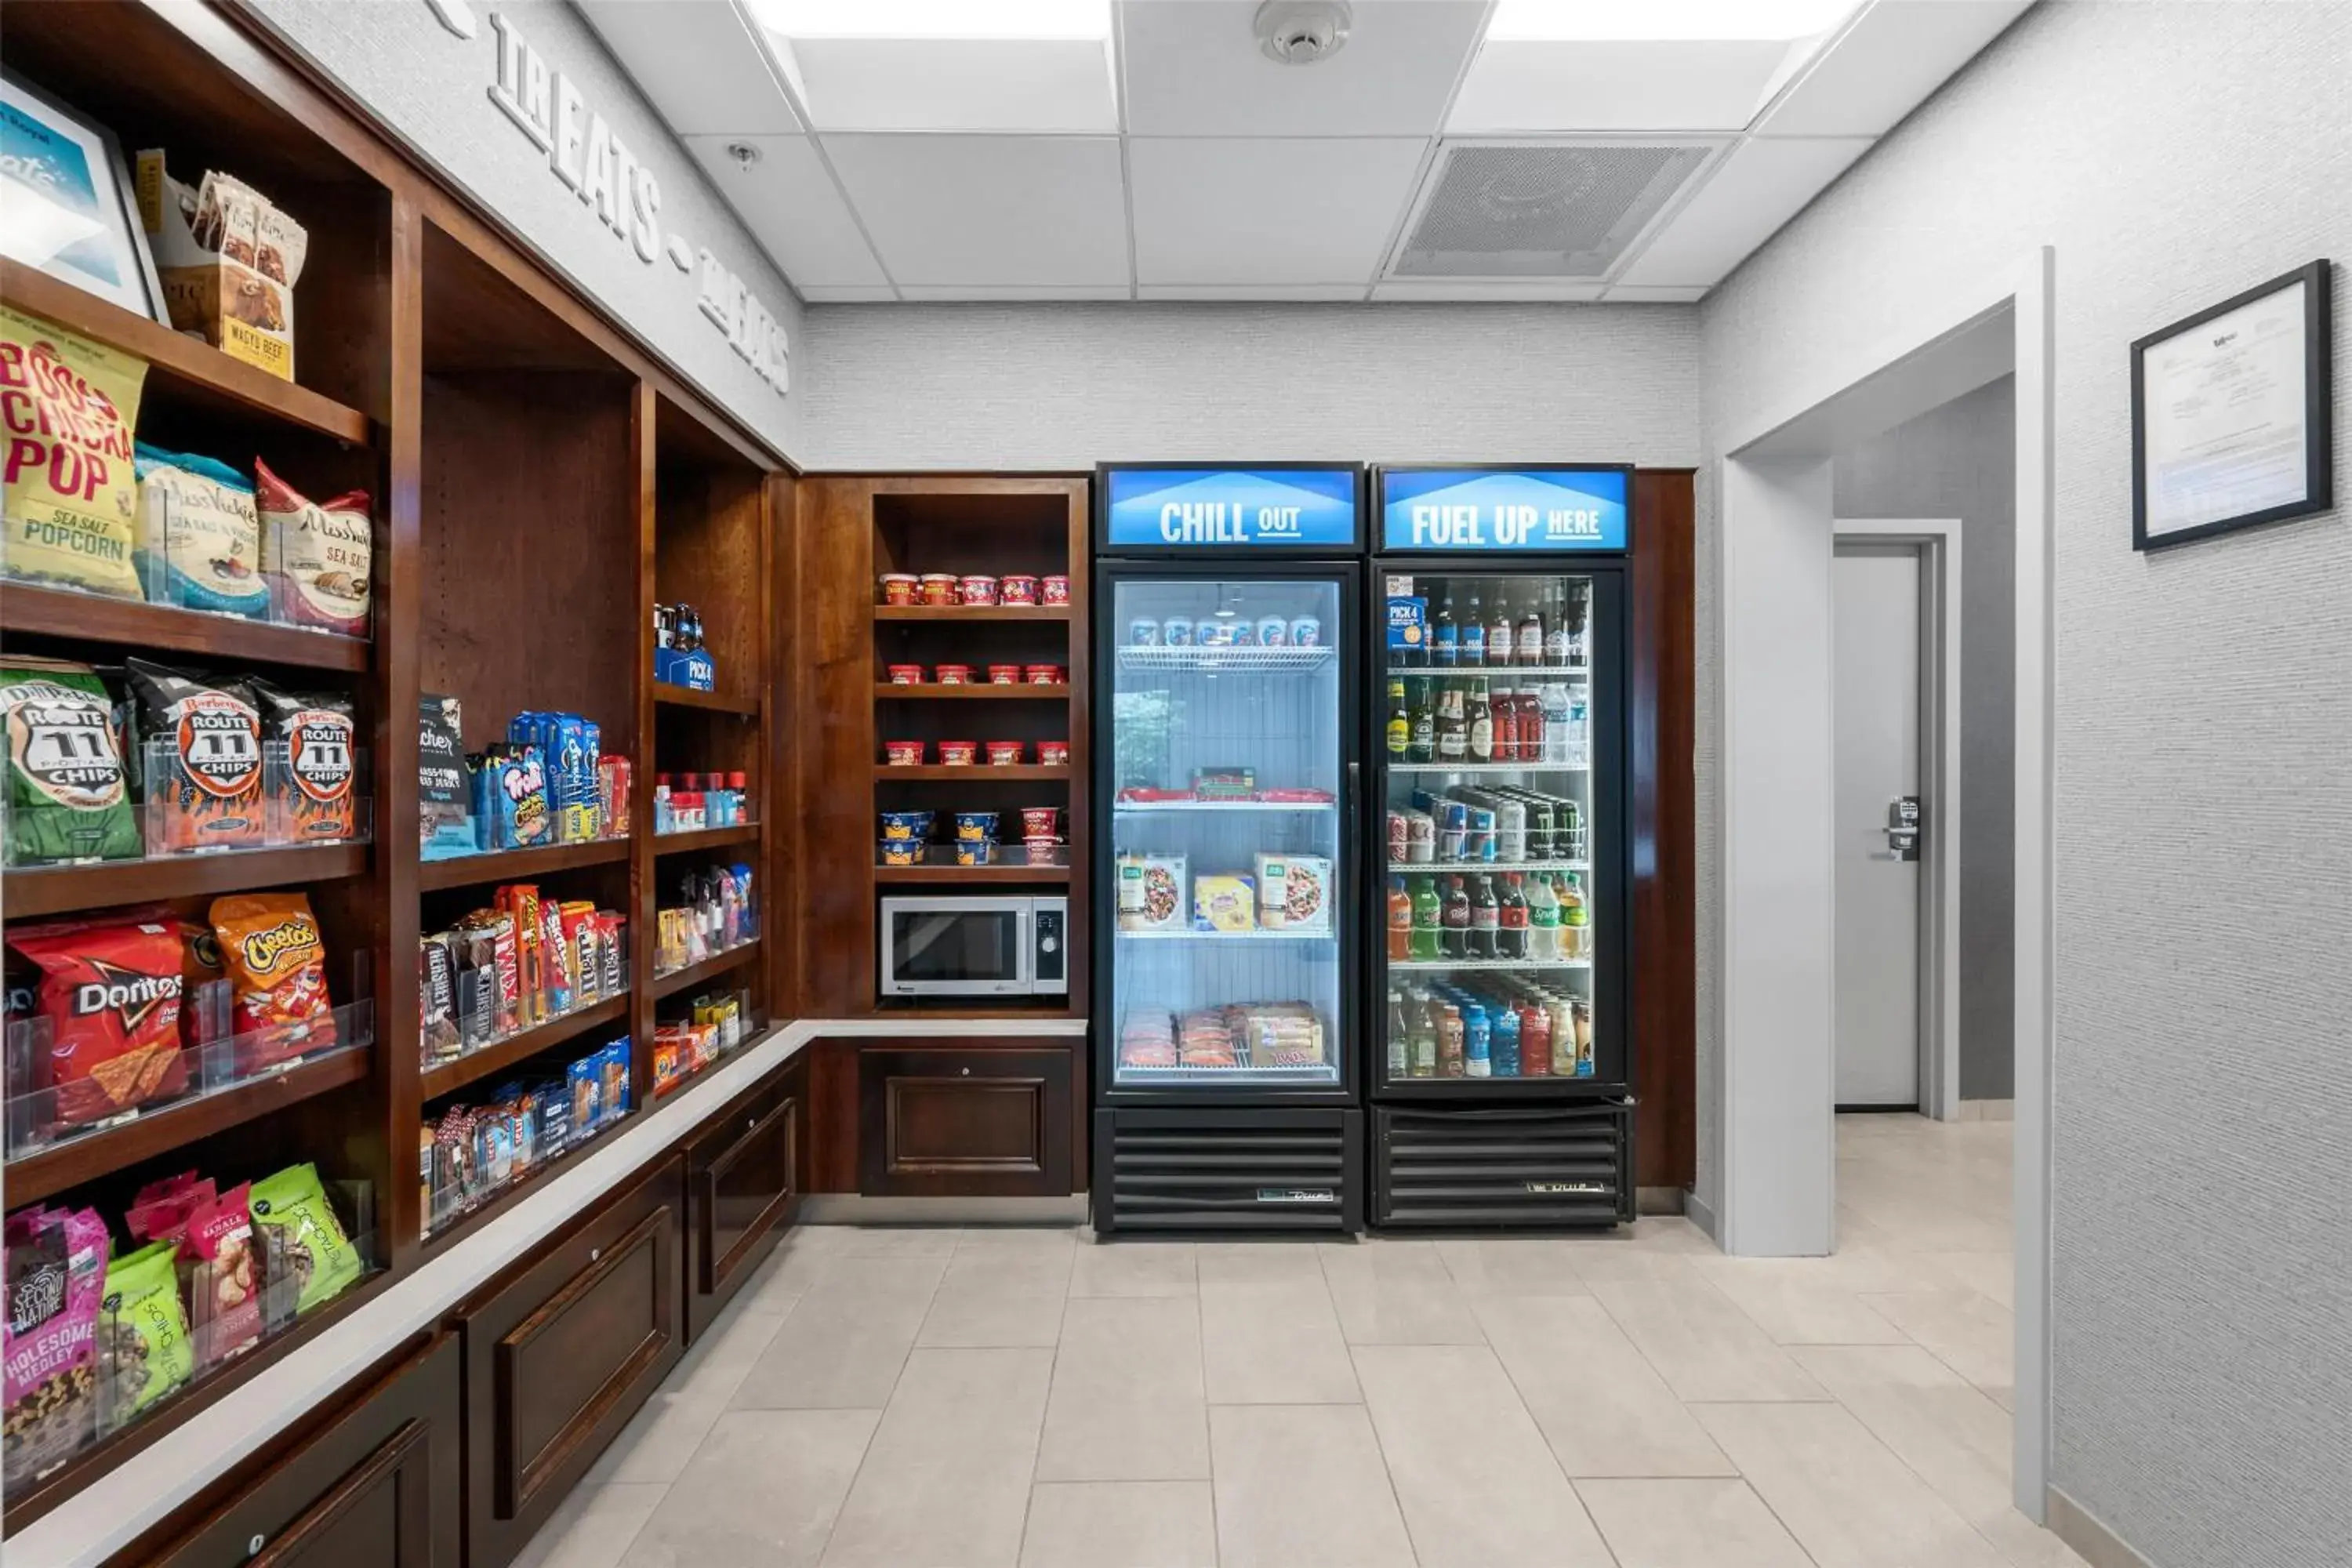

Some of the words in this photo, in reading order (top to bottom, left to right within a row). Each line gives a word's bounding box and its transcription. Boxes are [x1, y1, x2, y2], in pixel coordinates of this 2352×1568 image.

[487, 11, 660, 263] TREATS
[263, 339, 283, 358] BEEF
[3, 437, 108, 502] POP
[53, 510, 77, 528] SEA
[79, 517, 110, 535] SALT
[1160, 502, 1249, 542] CHILL
[1258, 506, 1301, 531] OUT
[1413, 506, 1486, 545] FUEL
[1494, 506, 1539, 545] UP
[1548, 510, 1599, 534] HERE
[24, 518, 124, 561] POPCORN
[326, 547, 346, 564] SEA
[348, 552, 368, 569] SALT
[1390, 606, 1410, 619] PICK
[24, 710, 103, 726] ROTE
[192, 716, 249, 729] ROUTE
[42, 731, 104, 758] 11
[201, 734, 246, 755] 11
[301, 730, 348, 742] ROUTE
[308, 746, 343, 764] 11
[49, 768, 118, 783] CHIPS
[200, 762, 252, 774] CHIPS
[306, 771, 346, 782] CHIPS
[247, 925, 314, 969] Cheetos
[429, 948, 452, 1014] HERSHEY'S
[79, 975, 183, 1014] Doritos
[5, 1322, 94, 1380] HOLESOME
[17, 1345, 74, 1388] MEDLEY
